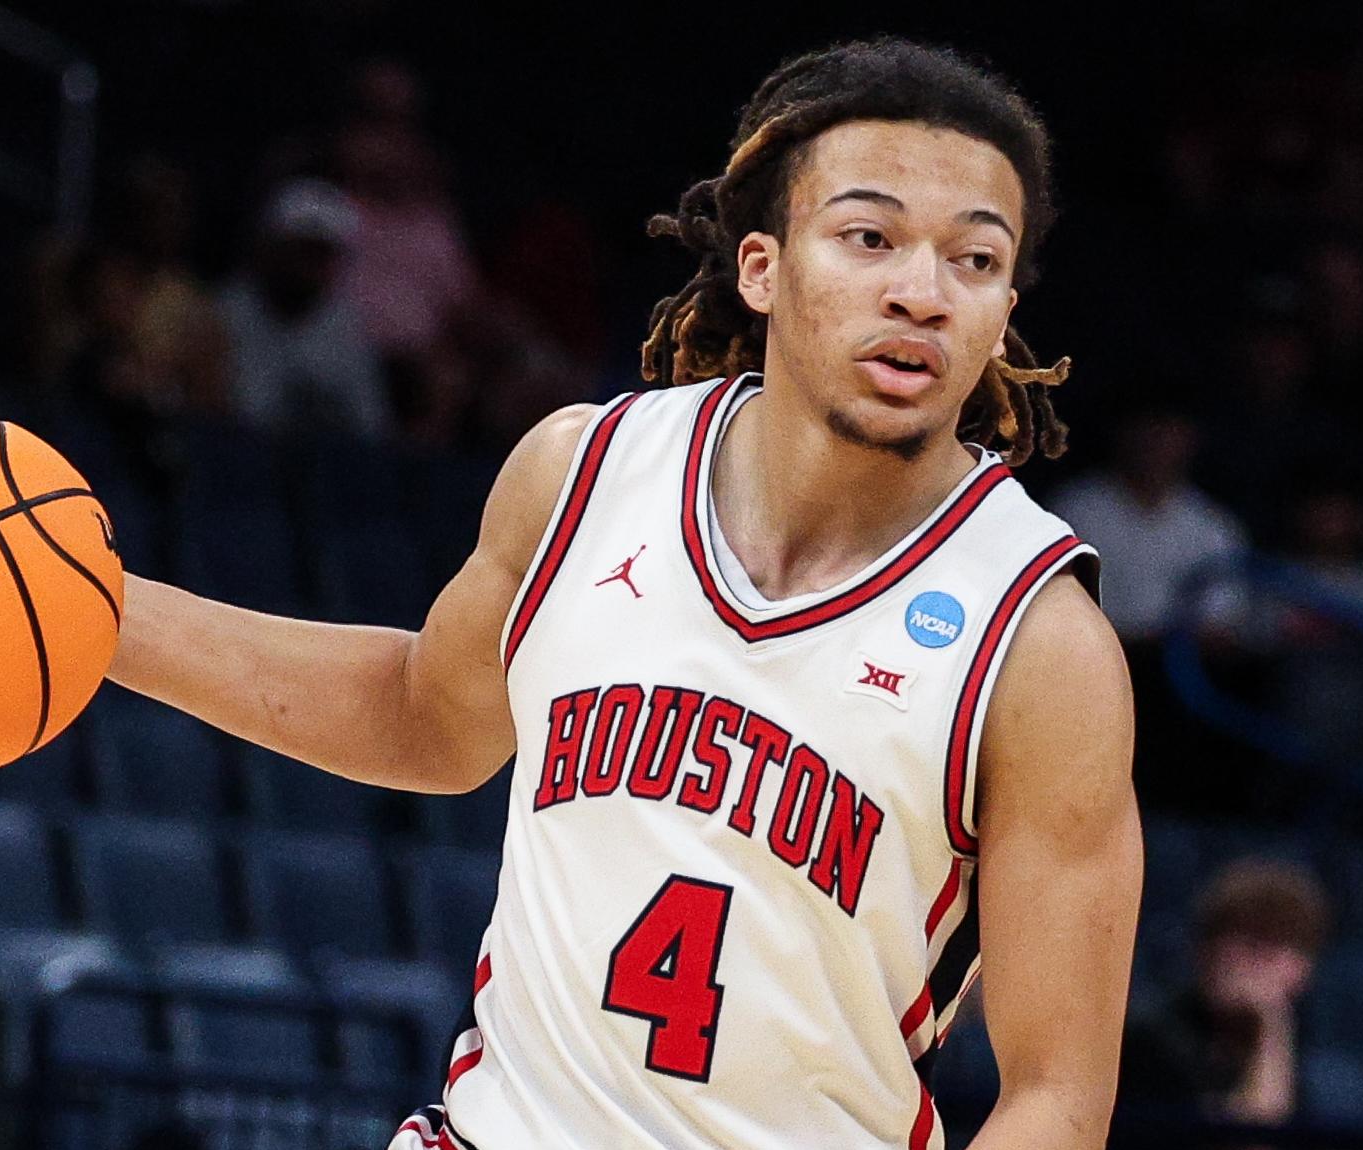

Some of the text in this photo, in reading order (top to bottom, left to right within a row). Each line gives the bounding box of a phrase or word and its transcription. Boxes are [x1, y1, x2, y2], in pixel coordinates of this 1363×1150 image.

[857, 661, 906, 697] XII
[909, 610, 959, 640] NCAA
[533, 683, 885, 918] HOUSTON
[601, 872, 734, 1084] 4
